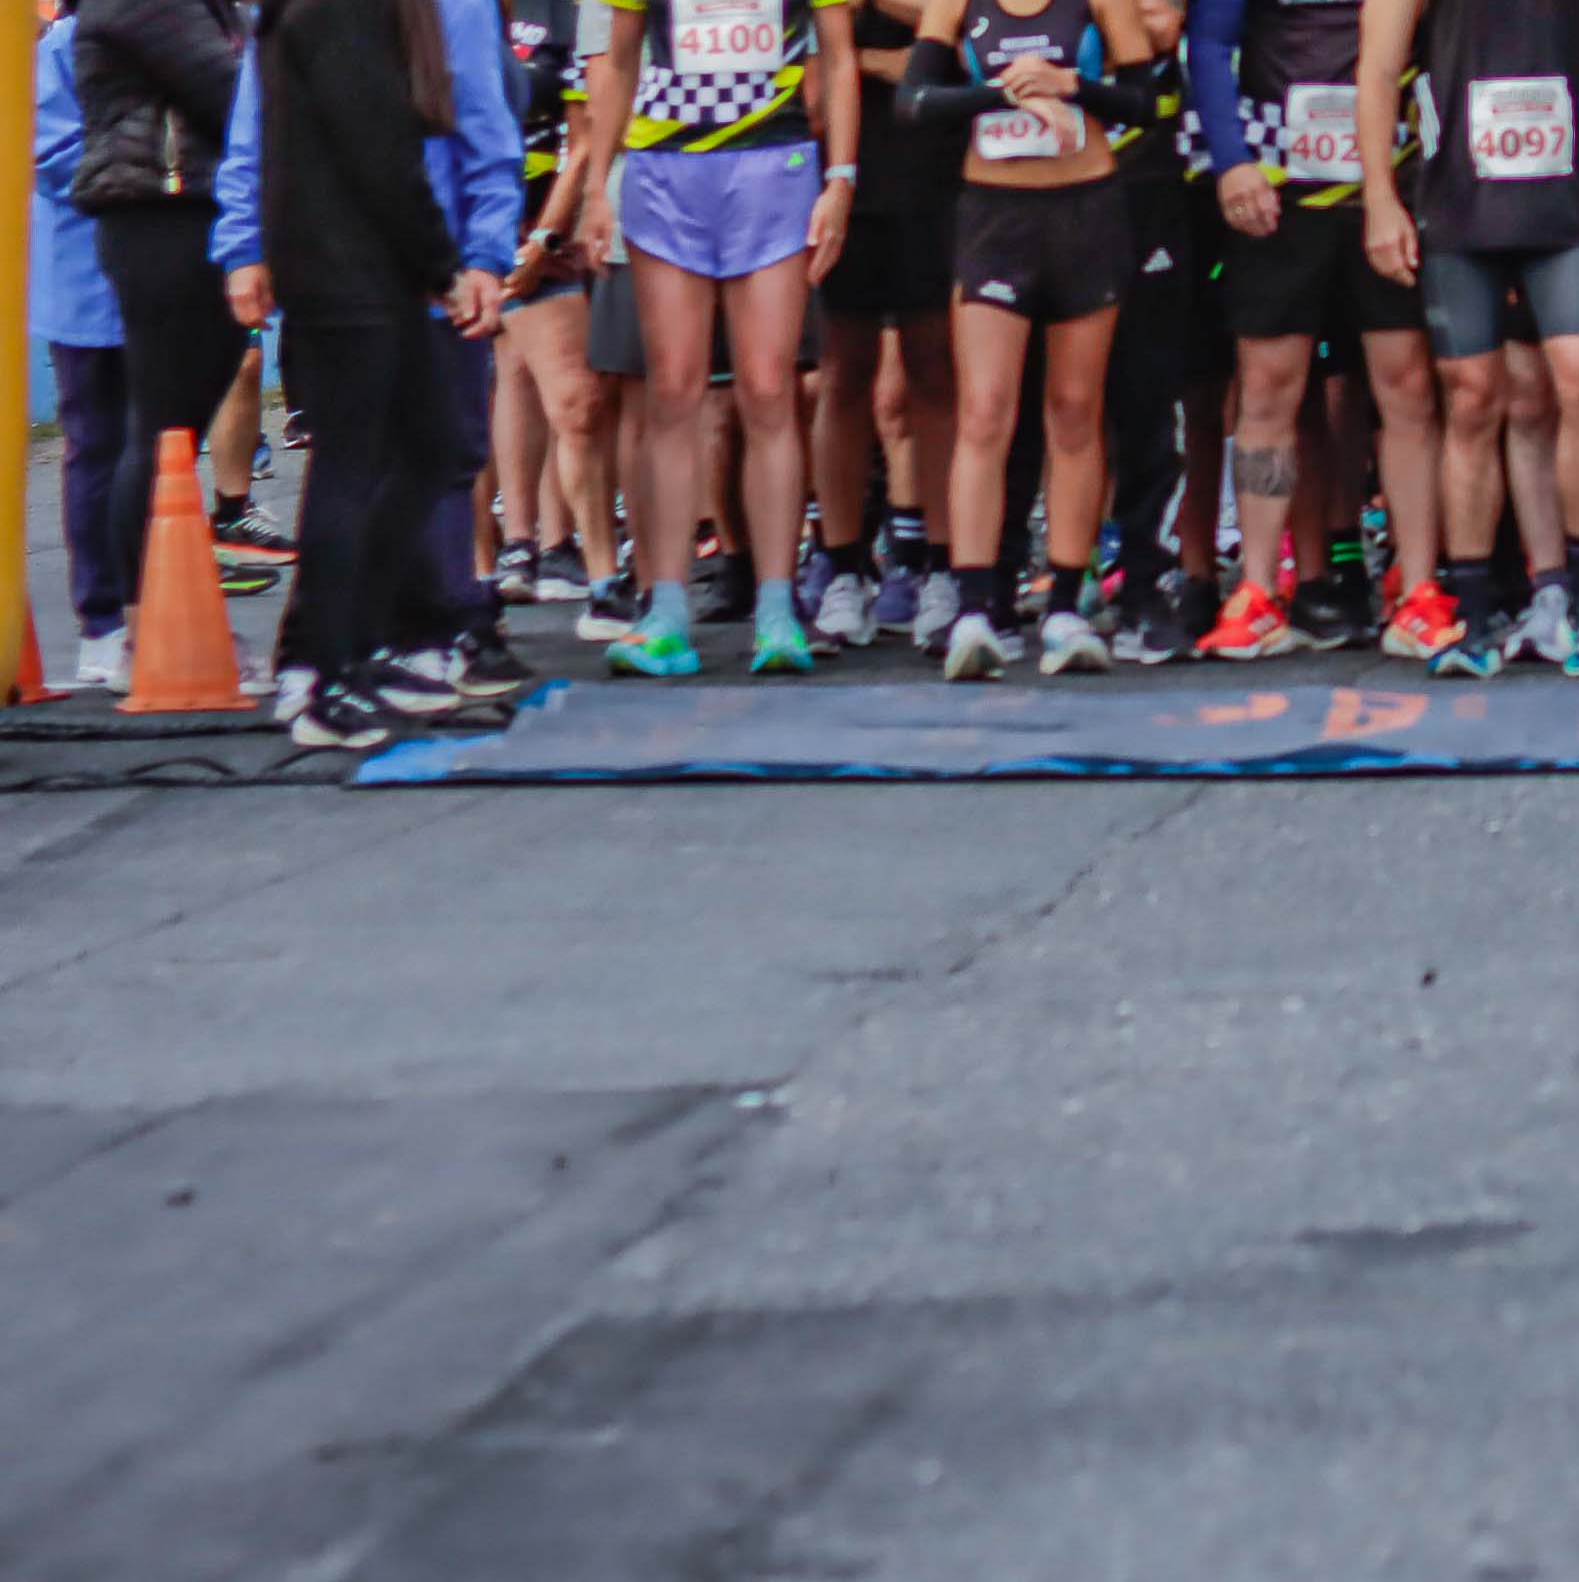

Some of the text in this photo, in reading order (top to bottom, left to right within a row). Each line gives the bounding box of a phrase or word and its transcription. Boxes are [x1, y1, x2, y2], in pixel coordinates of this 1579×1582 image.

[678, 23, 775, 55] 4100
[1291, 131, 1361, 163] 402
[1477, 126, 1568, 159] 4097
